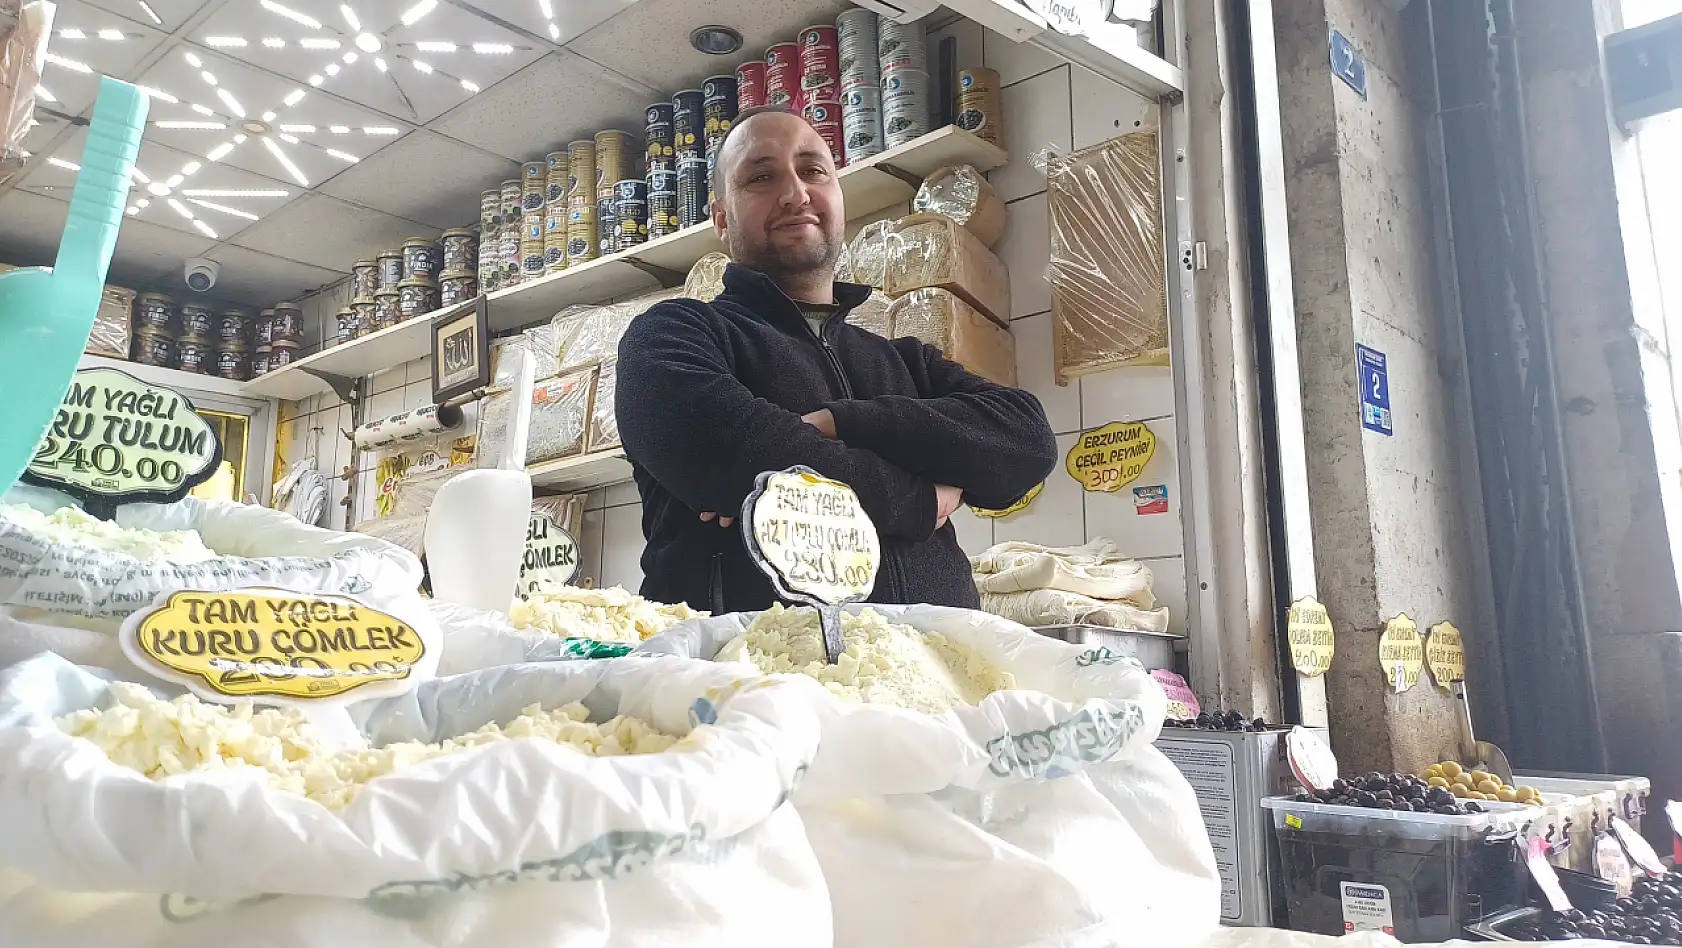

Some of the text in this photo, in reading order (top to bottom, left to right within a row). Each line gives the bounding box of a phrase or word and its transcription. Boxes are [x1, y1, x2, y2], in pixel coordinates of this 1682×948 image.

[1341, 46, 1355, 79] 2
[1371, 372, 1381, 400] 2
[104, 388, 178, 421] YAĞLI
[102, 414, 207, 456] TULUM
[1084, 426, 1142, 449] ERZURUM
[181, 598, 259, 625] TAM
[150, 621, 415, 660] KURU ÇÖMLEK
